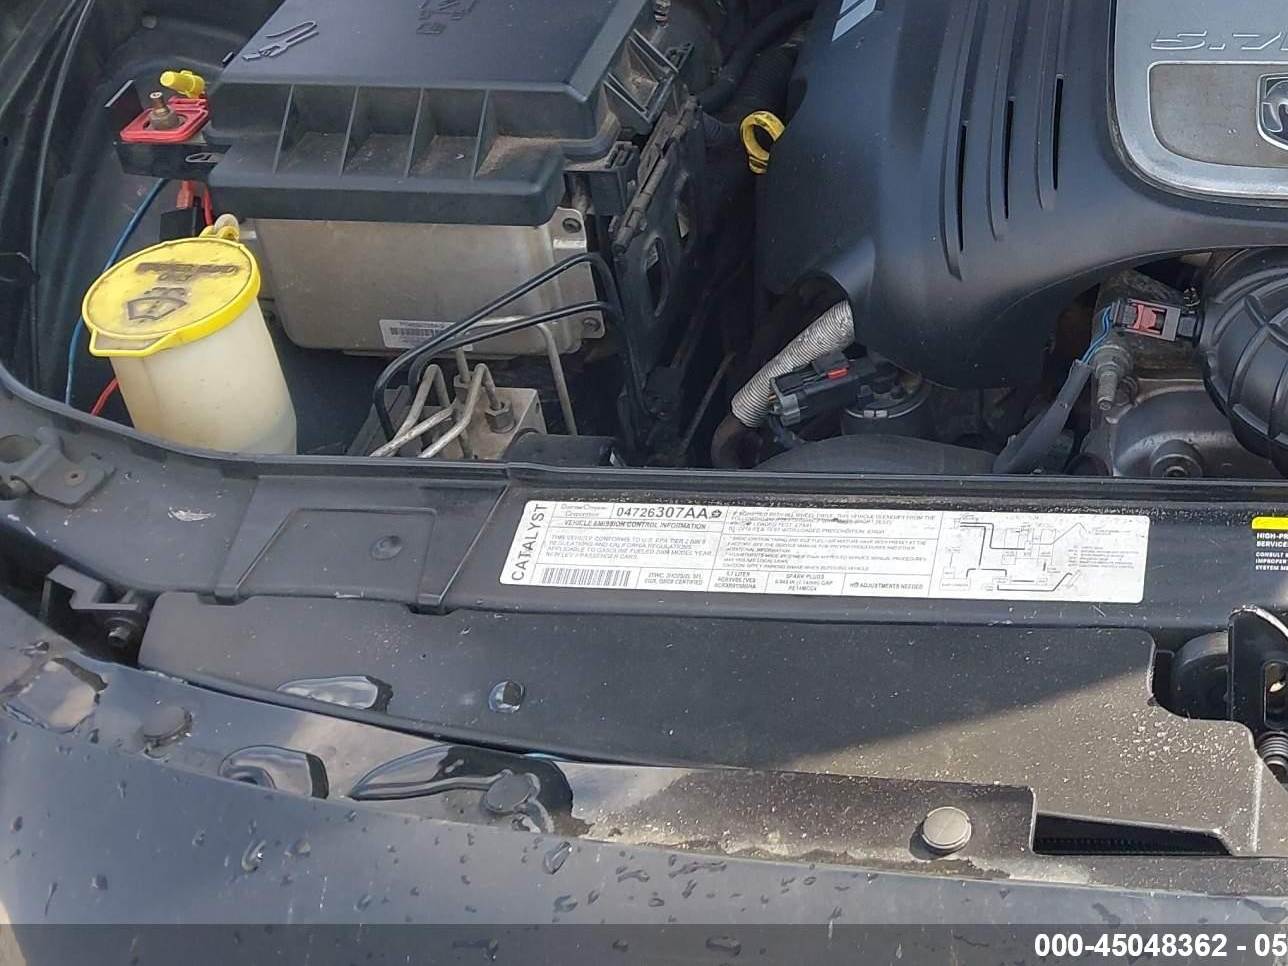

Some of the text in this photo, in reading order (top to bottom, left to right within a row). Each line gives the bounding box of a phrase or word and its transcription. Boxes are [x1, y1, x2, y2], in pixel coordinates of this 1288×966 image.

[616, 506, 709, 520] 04726307AA
[564, 519, 591, 527] VEHICLE
[626, 521, 657, 529] CONTROL
[659, 522, 706, 530] INFORMATION
[511, 503, 549, 581] CATALYST
[1255, 551, 1283, 559] CONSULT
